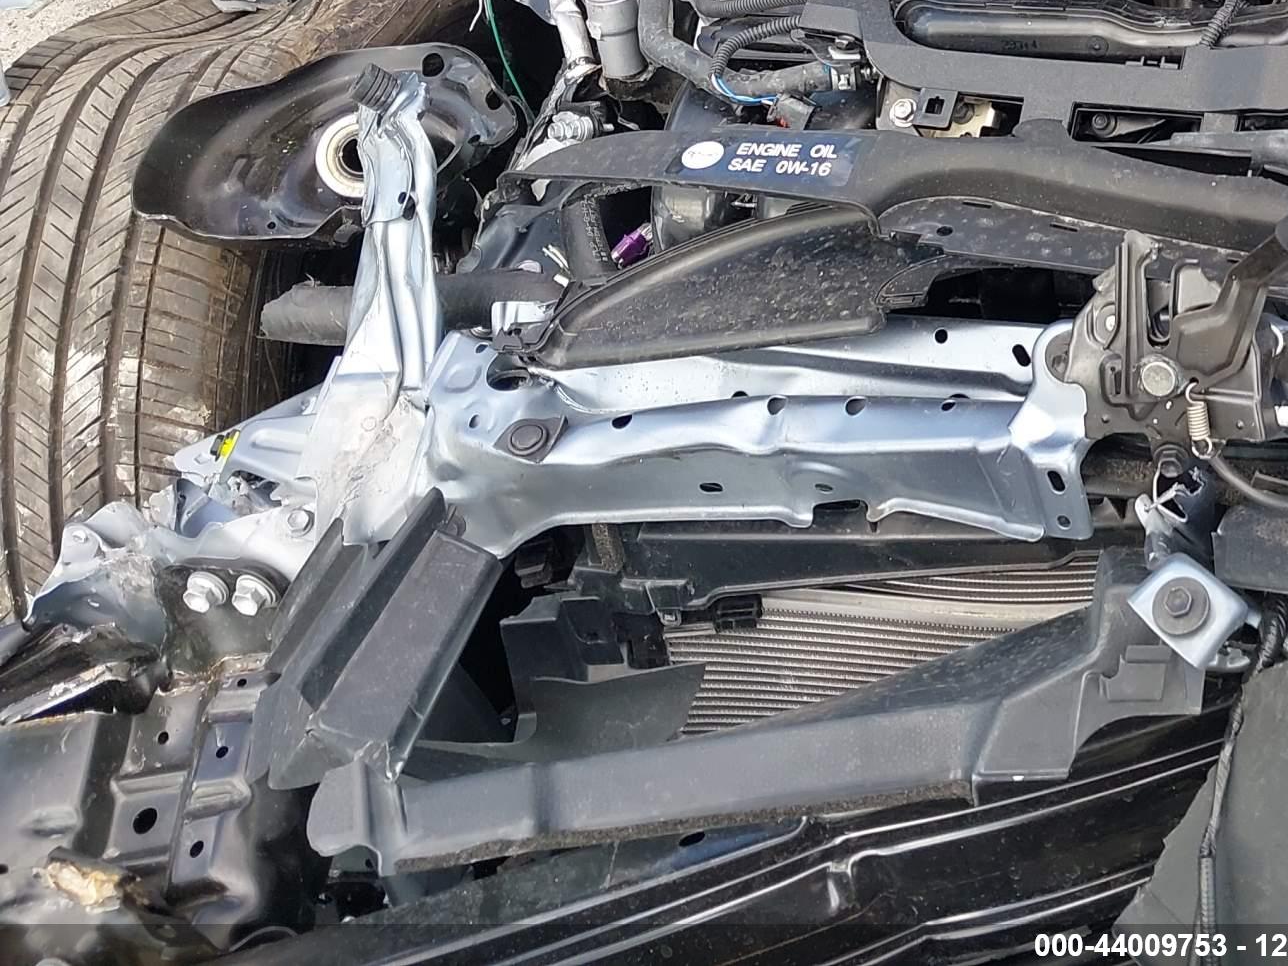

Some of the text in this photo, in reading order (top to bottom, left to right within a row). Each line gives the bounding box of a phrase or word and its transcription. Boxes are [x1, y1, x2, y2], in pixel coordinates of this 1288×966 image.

[736, 142, 802, 158] ENGINE
[809, 144, 838, 159] OIL
[728, 158, 767, 172] SAE
